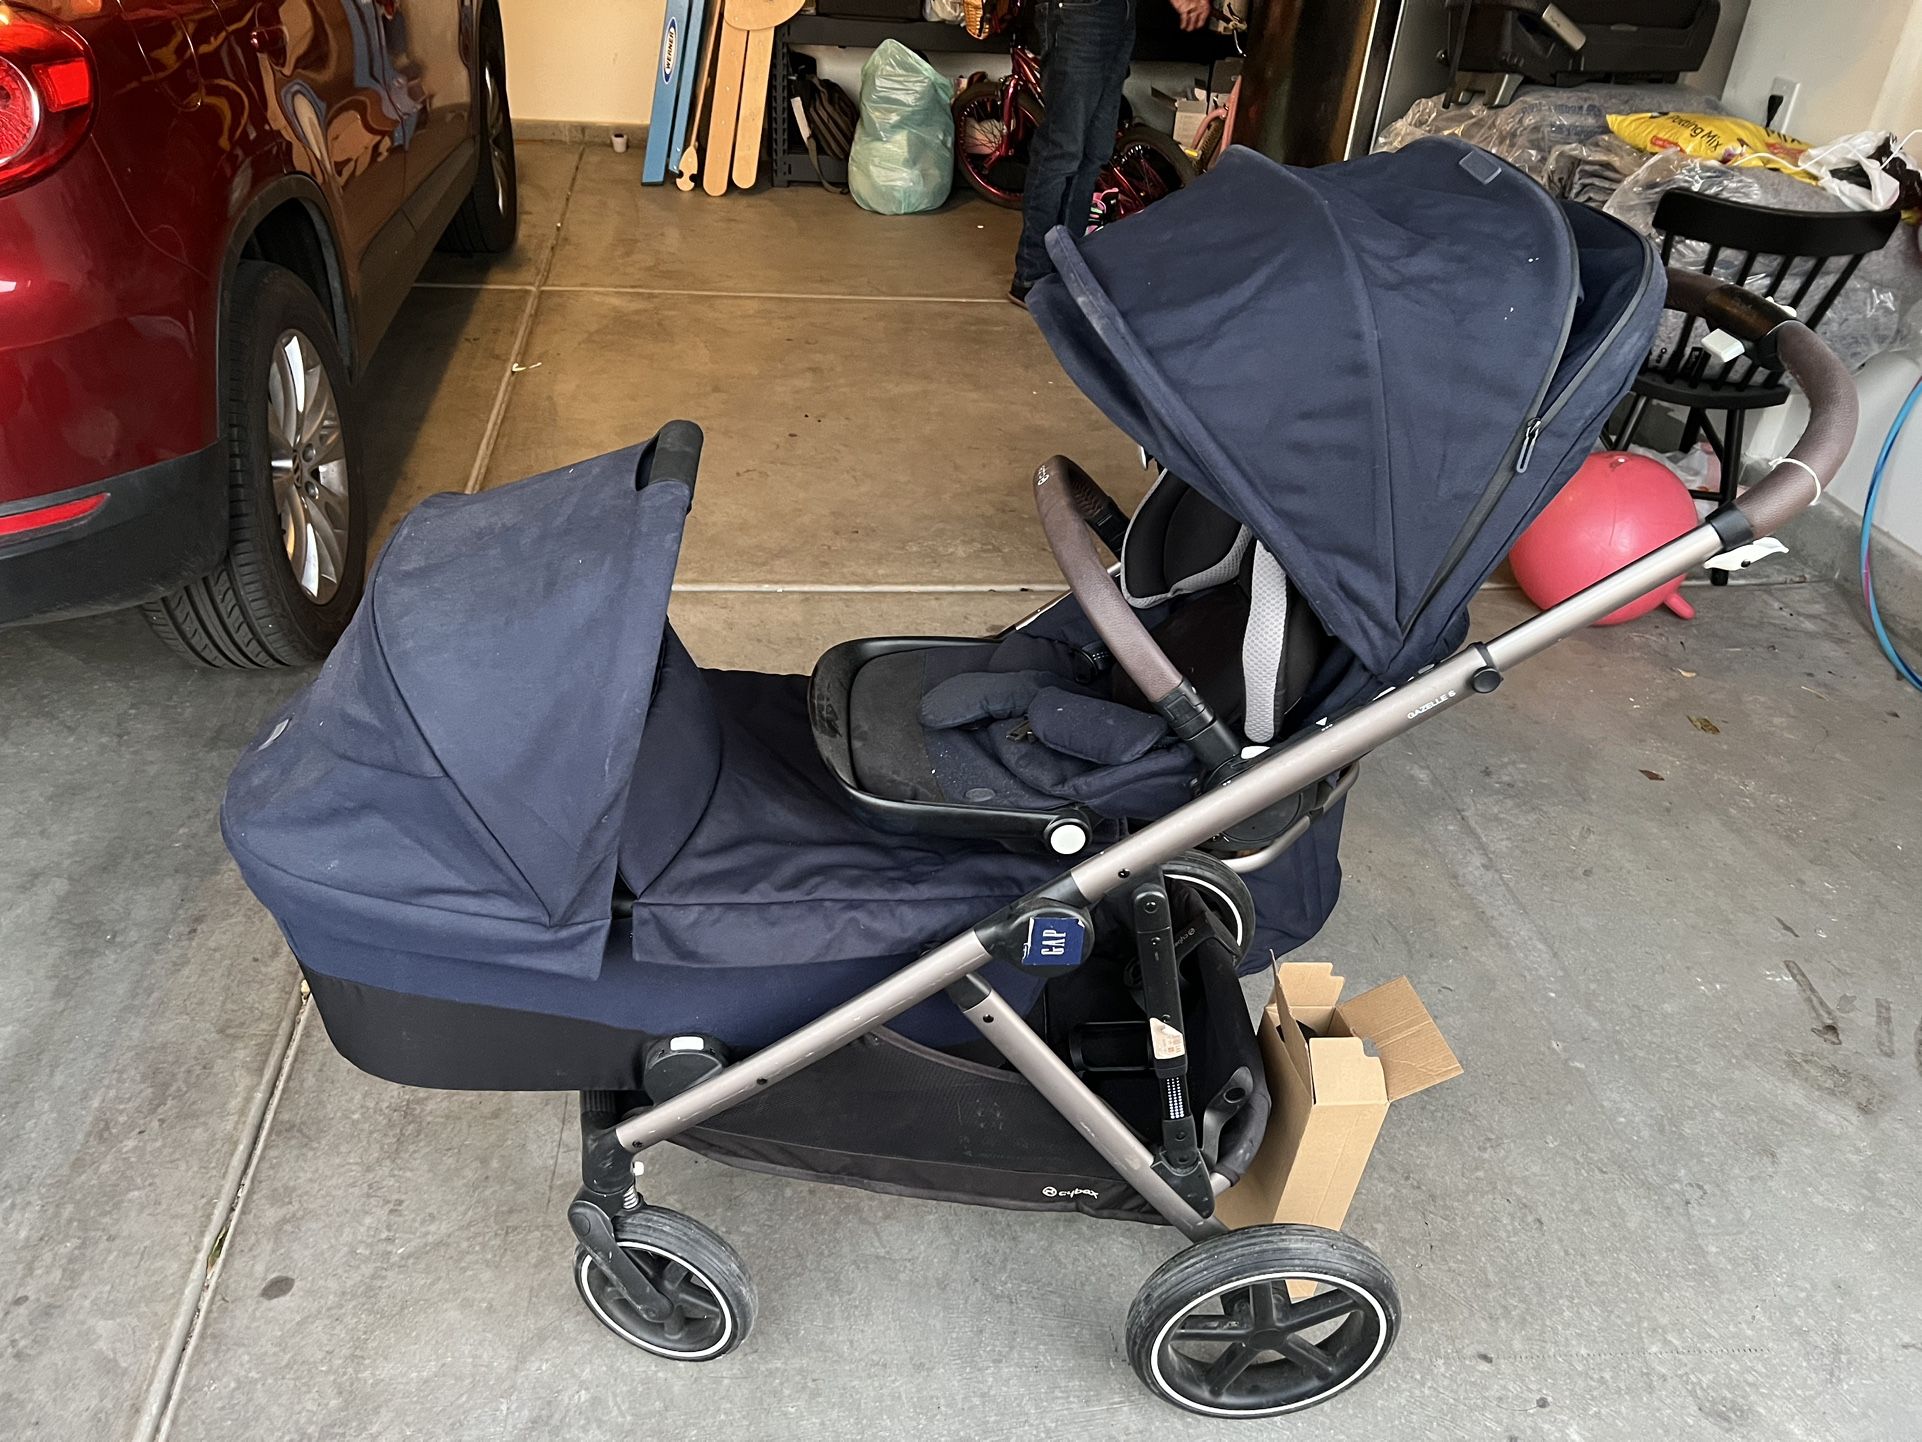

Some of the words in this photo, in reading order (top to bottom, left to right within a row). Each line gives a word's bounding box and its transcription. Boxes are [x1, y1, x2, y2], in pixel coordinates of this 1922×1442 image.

[665, 31, 674, 70] WERNER
[1700, 130, 1724, 151] Mix
[1406, 693, 1449, 720] GAZELLE
[1040, 929, 1067, 956] GAP
[1058, 1187, 1099, 1200] cybex
